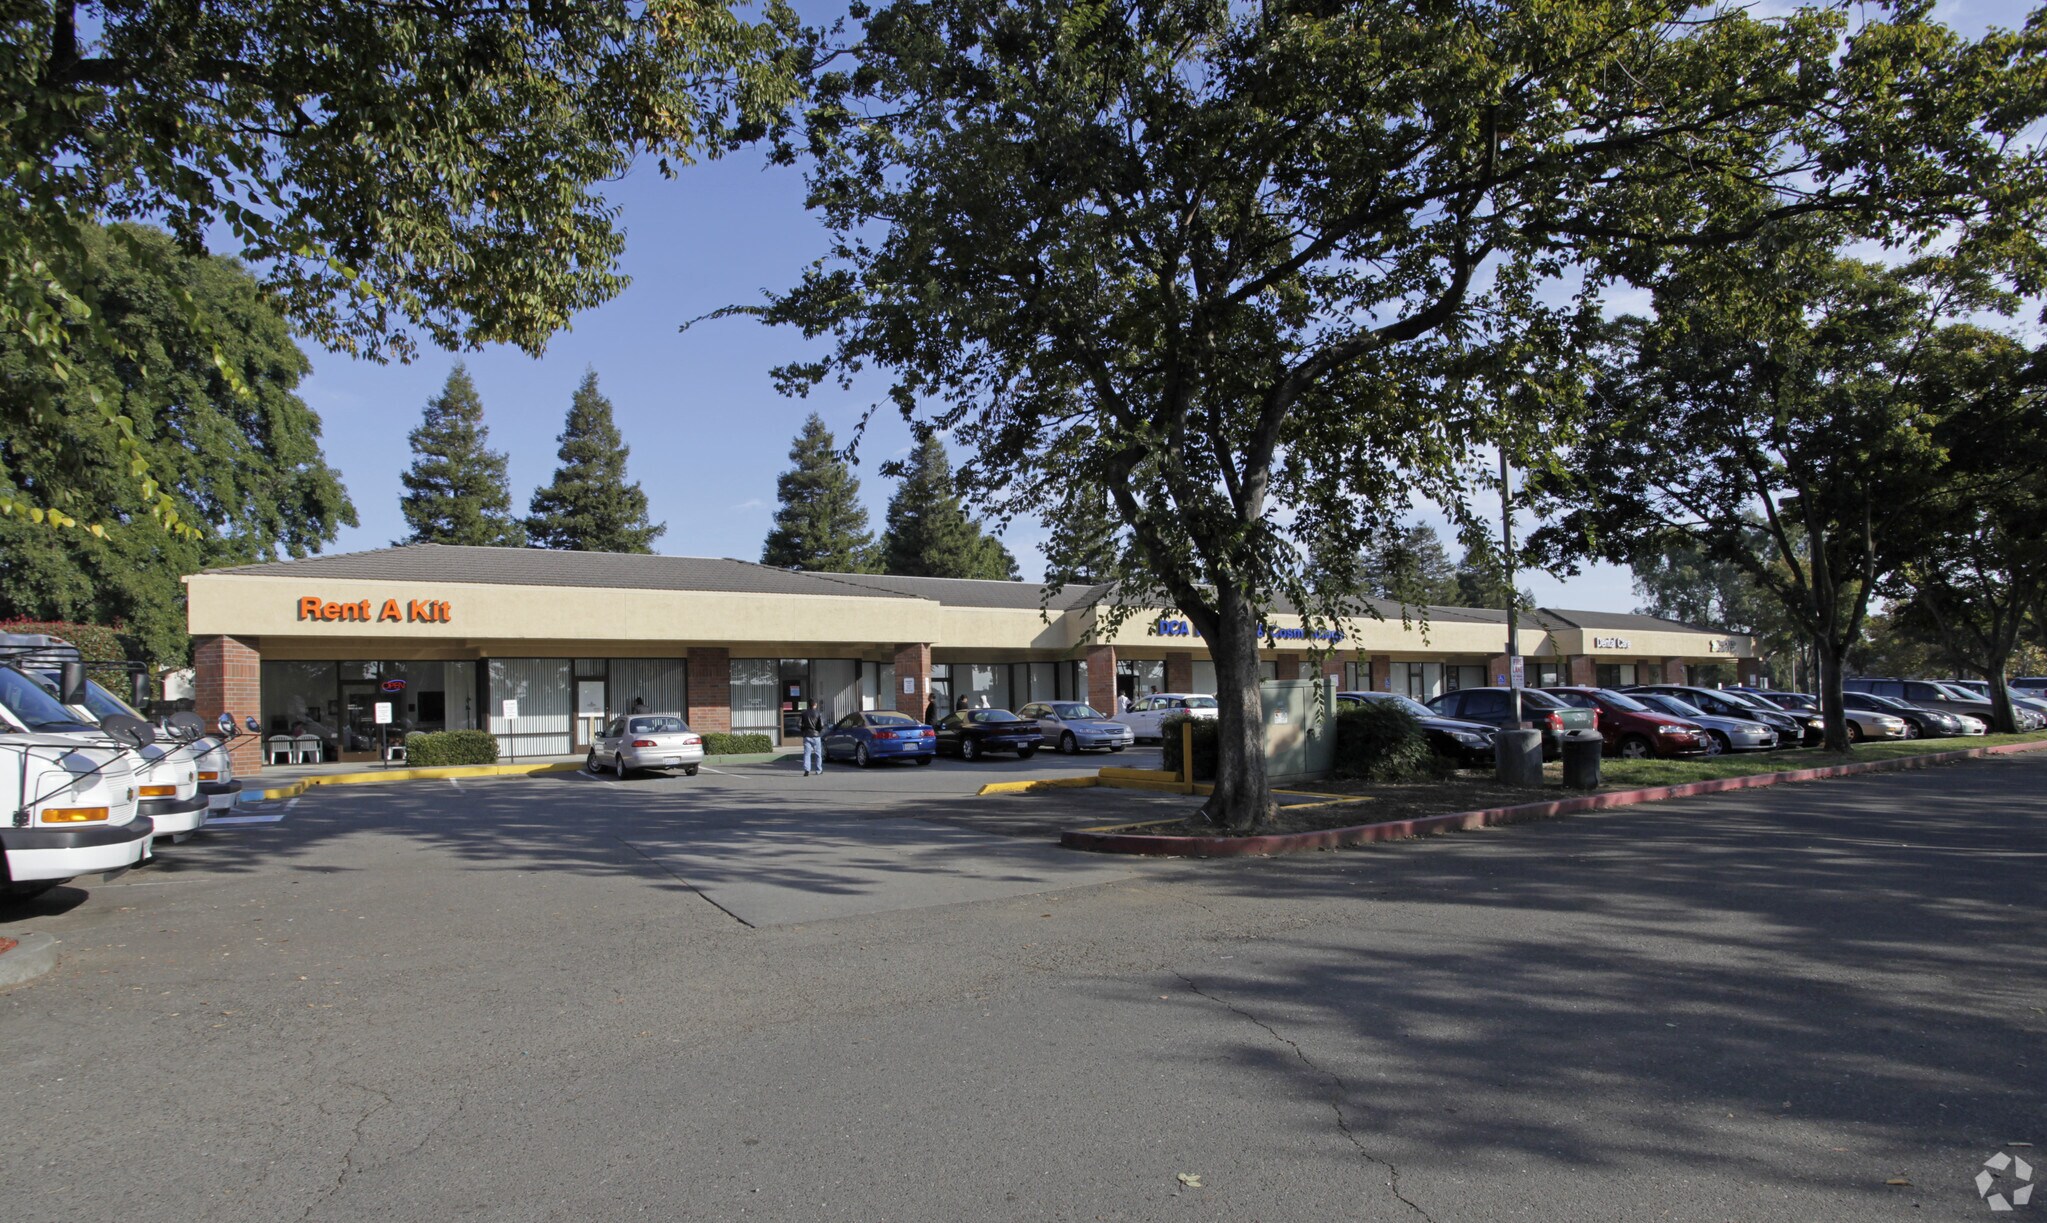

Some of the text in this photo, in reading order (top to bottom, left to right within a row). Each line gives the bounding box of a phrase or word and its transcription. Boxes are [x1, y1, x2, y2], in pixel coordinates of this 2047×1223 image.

[299, 596, 452, 623] Rent A Kit
[1157, 620, 1190, 636] DCA
[1594, 637, 1632, 649] Dental Care
[381, 681, 407, 689] OPEN
